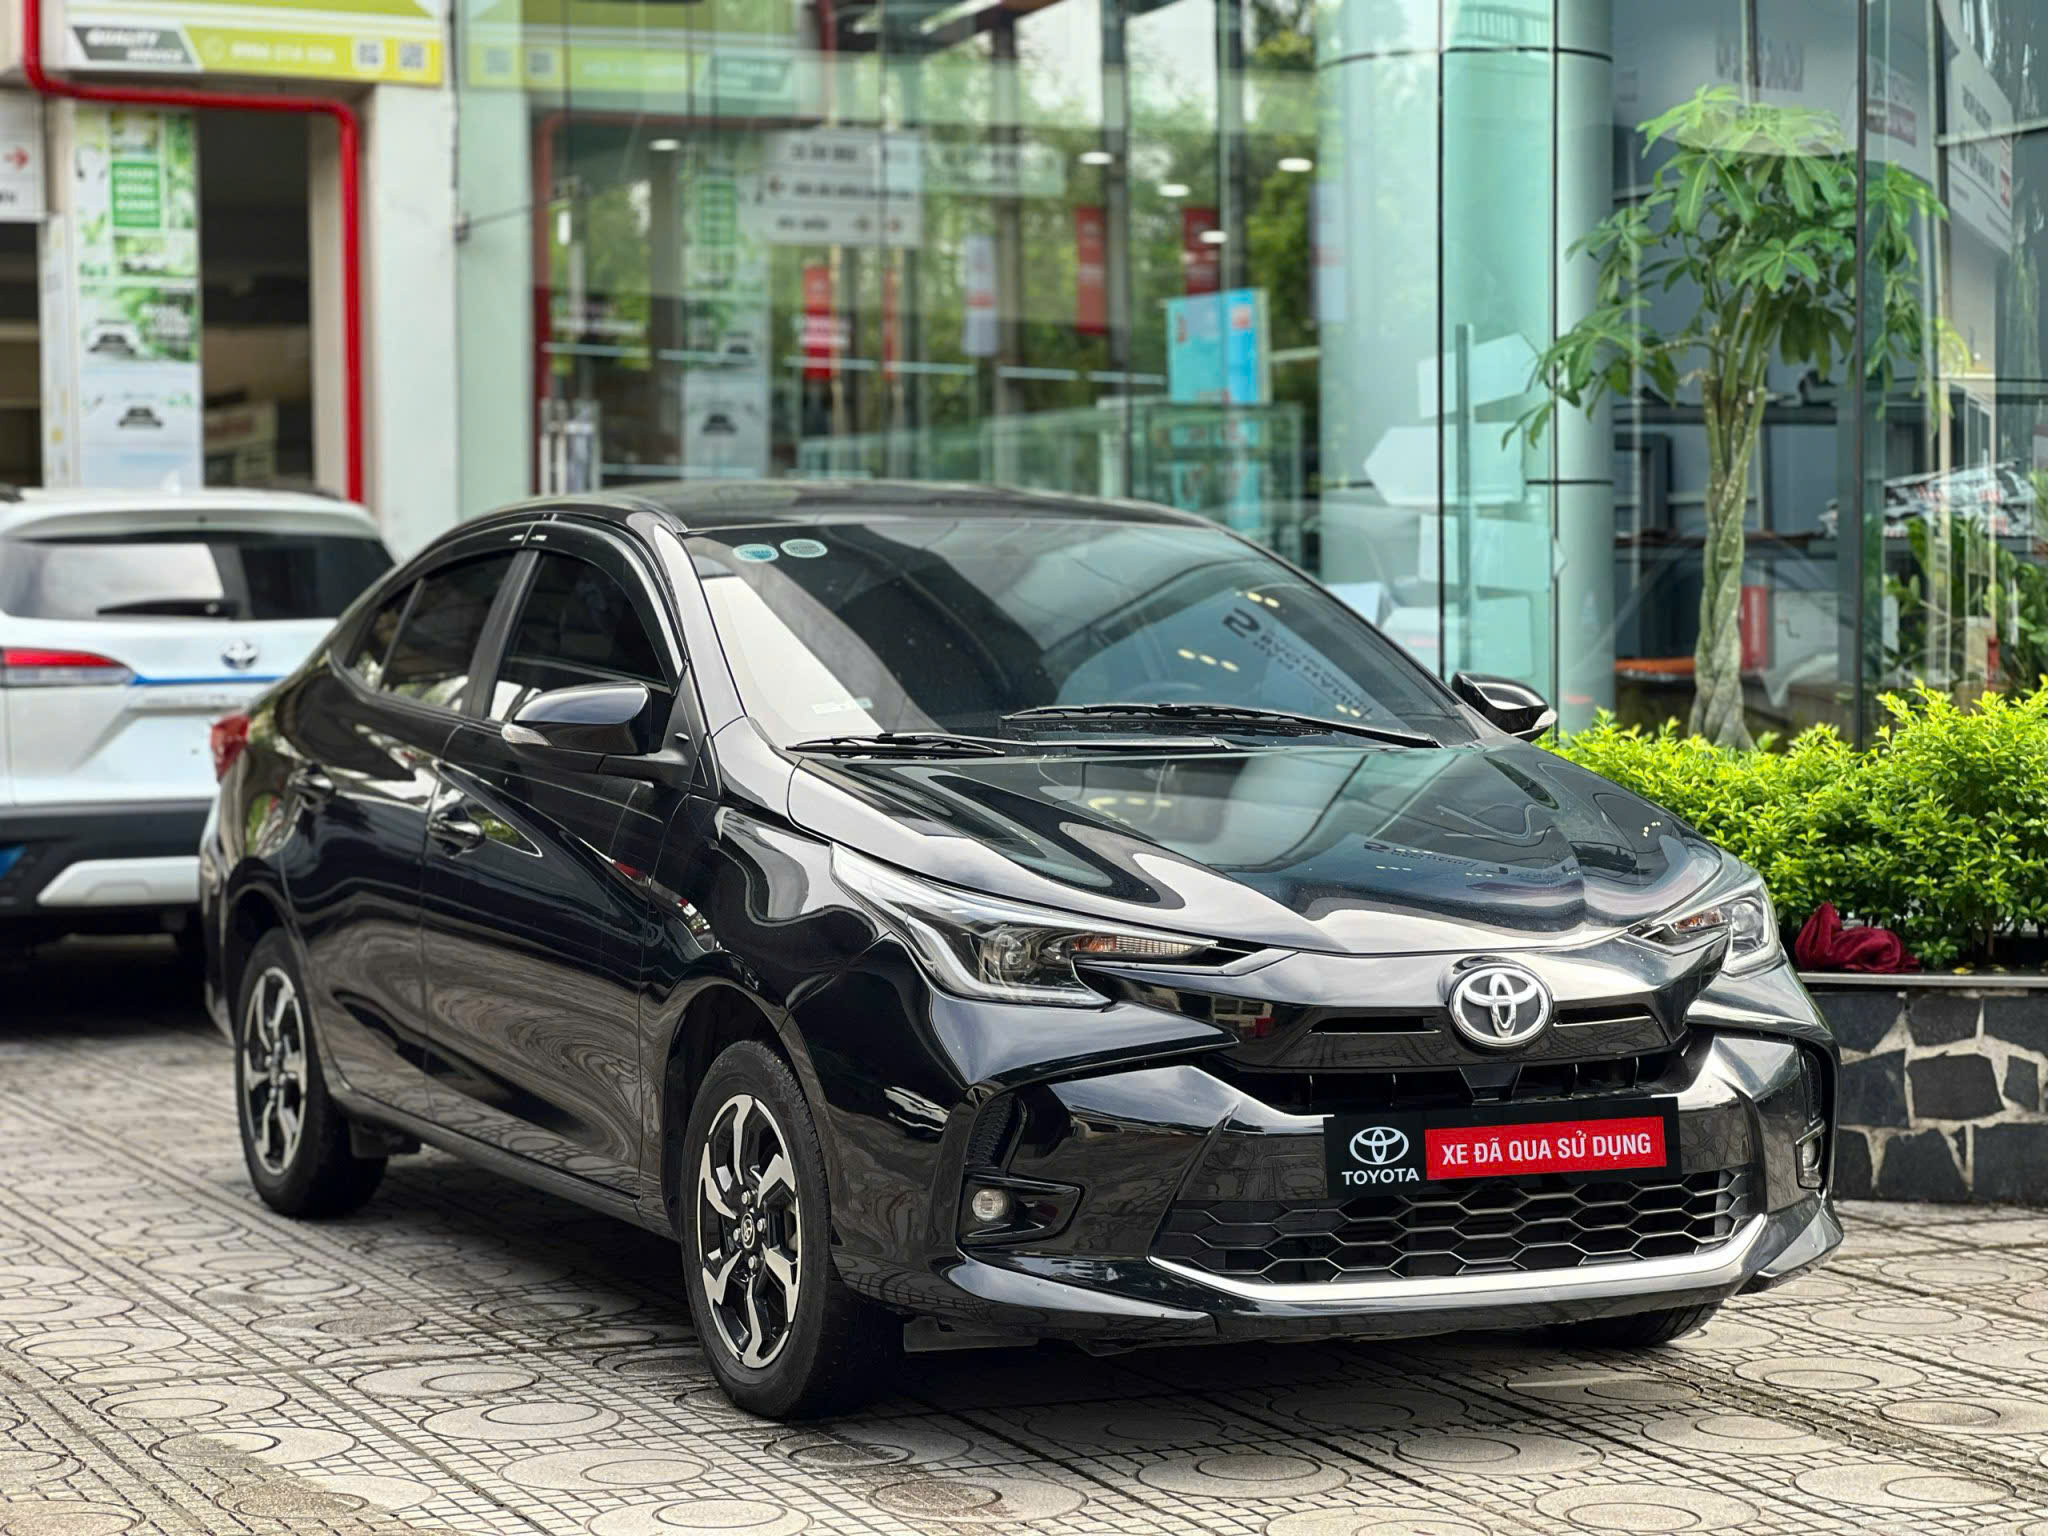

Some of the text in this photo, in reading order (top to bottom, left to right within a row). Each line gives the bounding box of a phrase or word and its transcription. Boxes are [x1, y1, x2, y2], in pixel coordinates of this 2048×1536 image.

[1442, 1130, 1652, 1166] XE ĐÃ QUA SỬ DỤNG
[1341, 1167, 1421, 1186] TOYOTA
